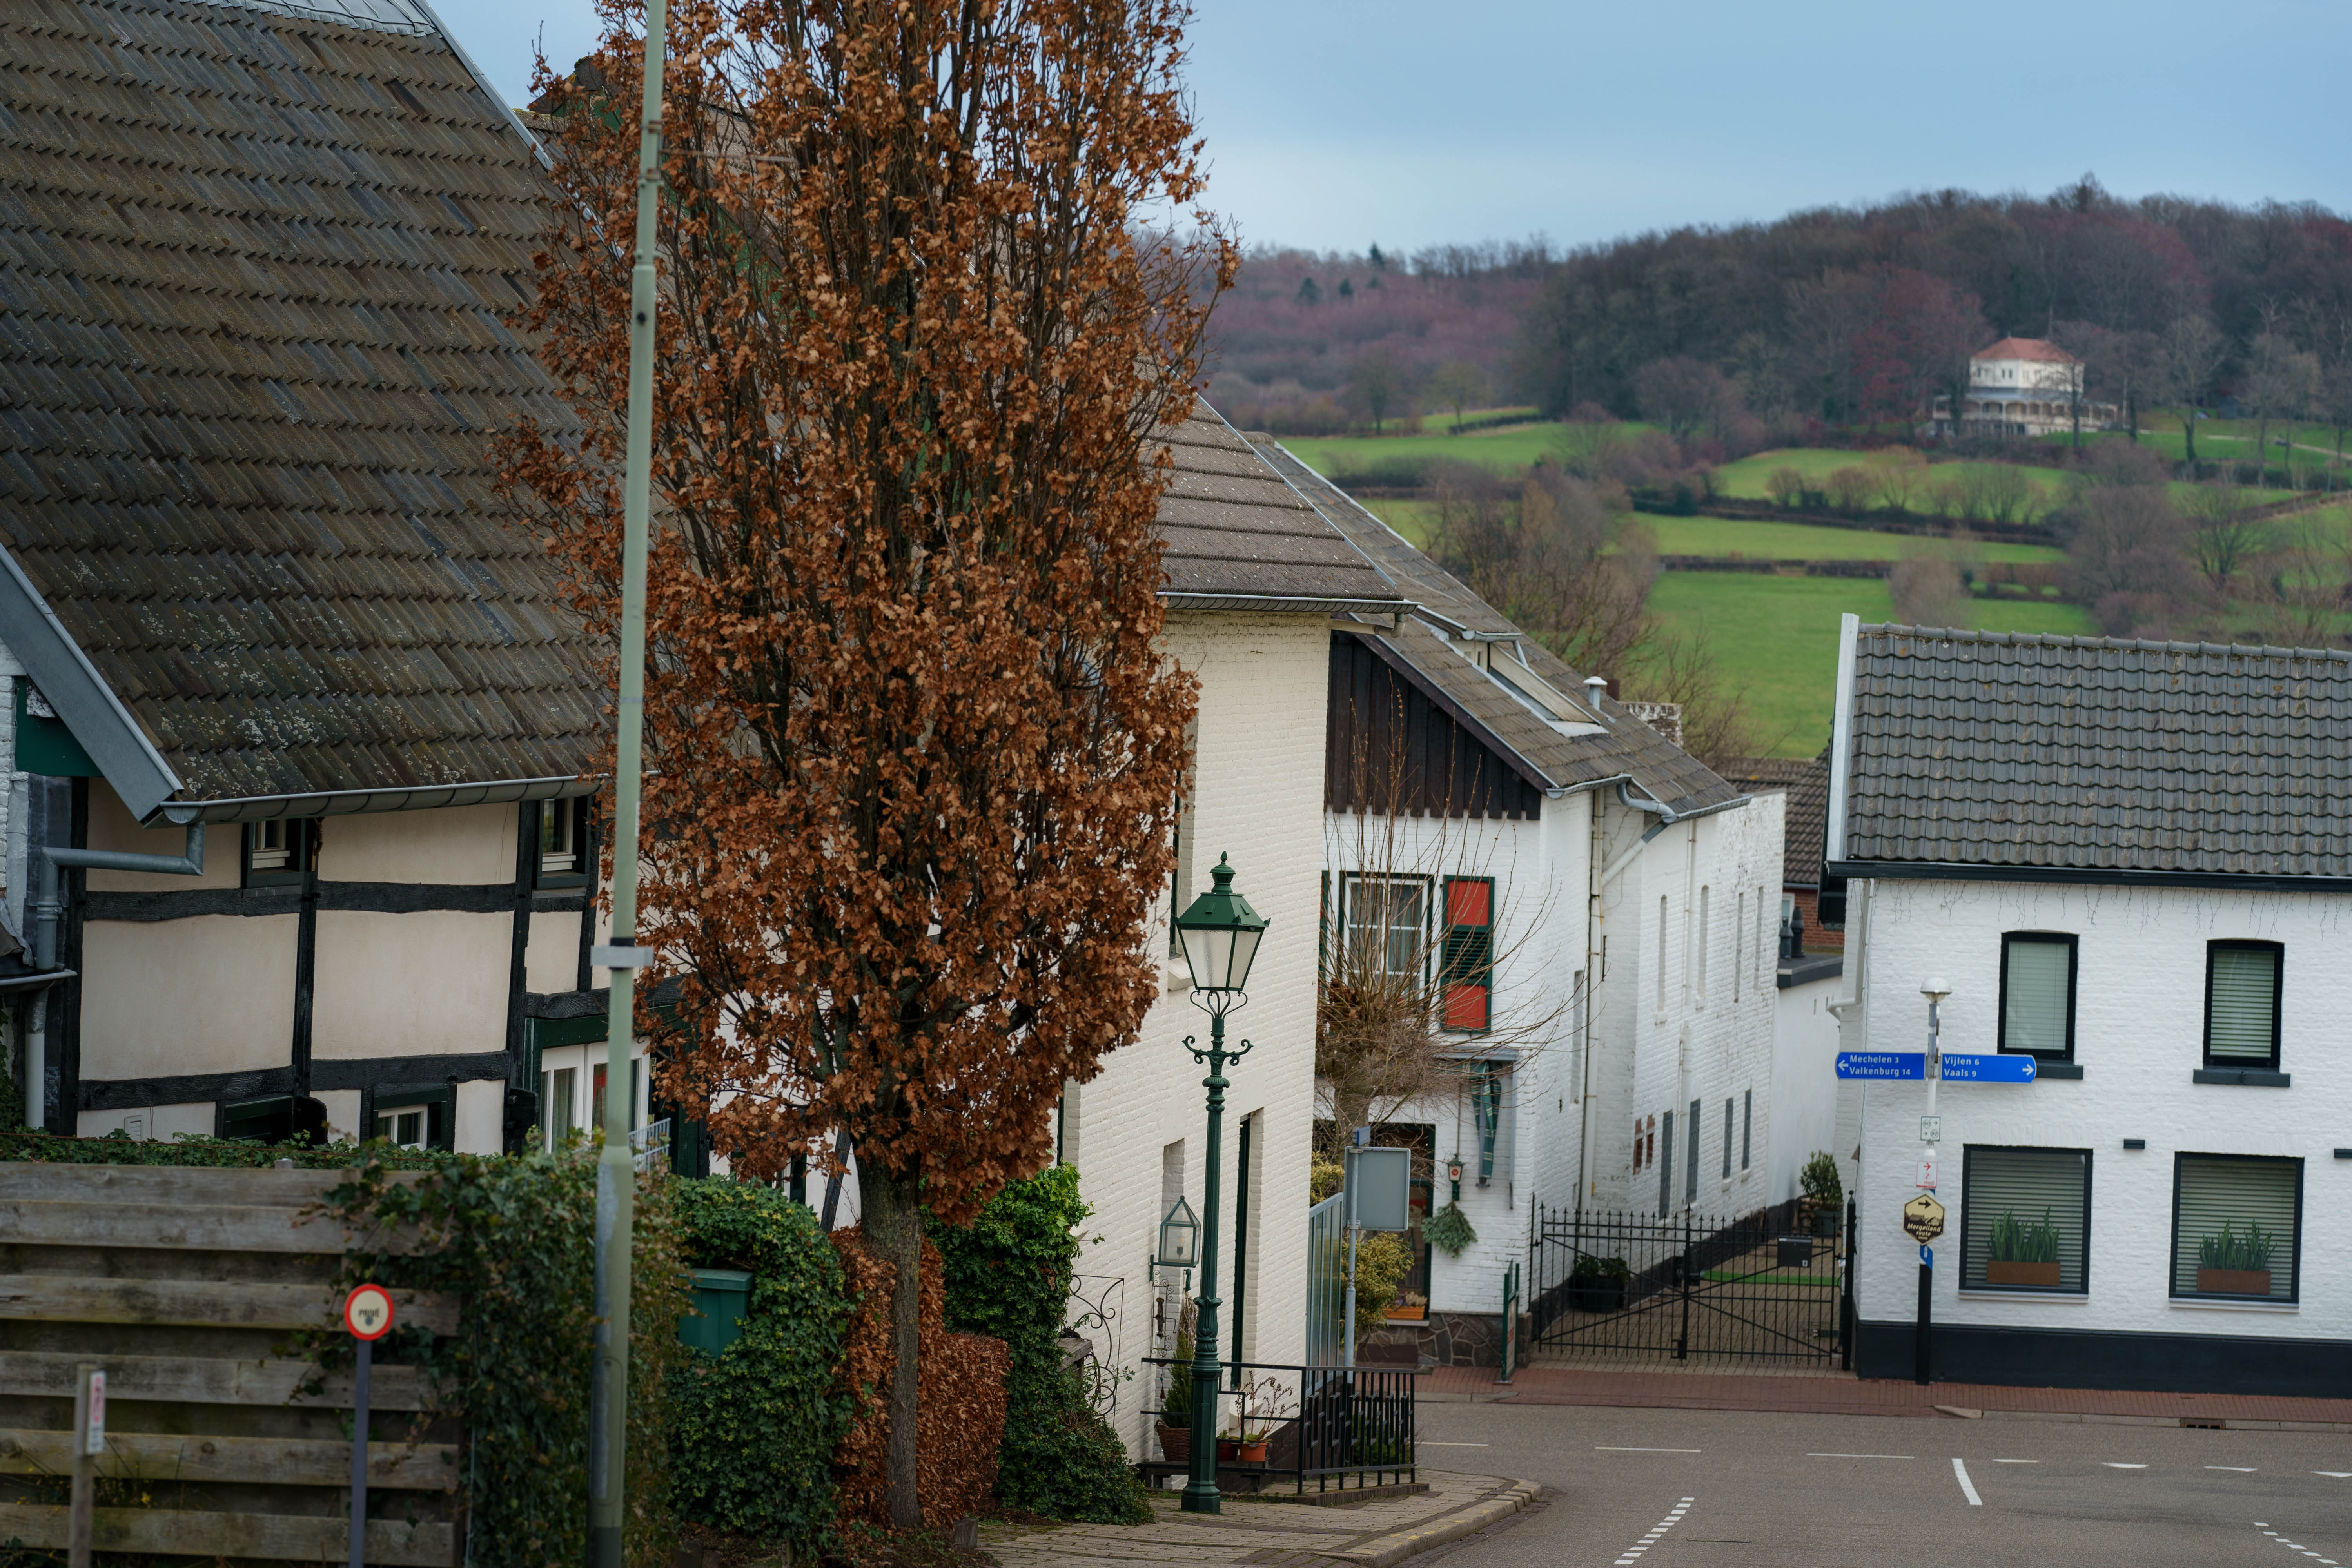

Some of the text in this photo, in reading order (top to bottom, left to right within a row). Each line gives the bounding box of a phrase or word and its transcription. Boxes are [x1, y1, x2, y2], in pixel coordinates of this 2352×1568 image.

[1849, 1055, 1892, 1063] Mechelen
[1944, 1056, 1971, 1067] Vijlen
[1849, 1067, 1900, 1077] Valkenburg
[1944, 1068, 1969, 1077] Vaals
[1907, 1223, 1941, 1232] Mergelland
[1802, 1259, 1808, 1267] 13
